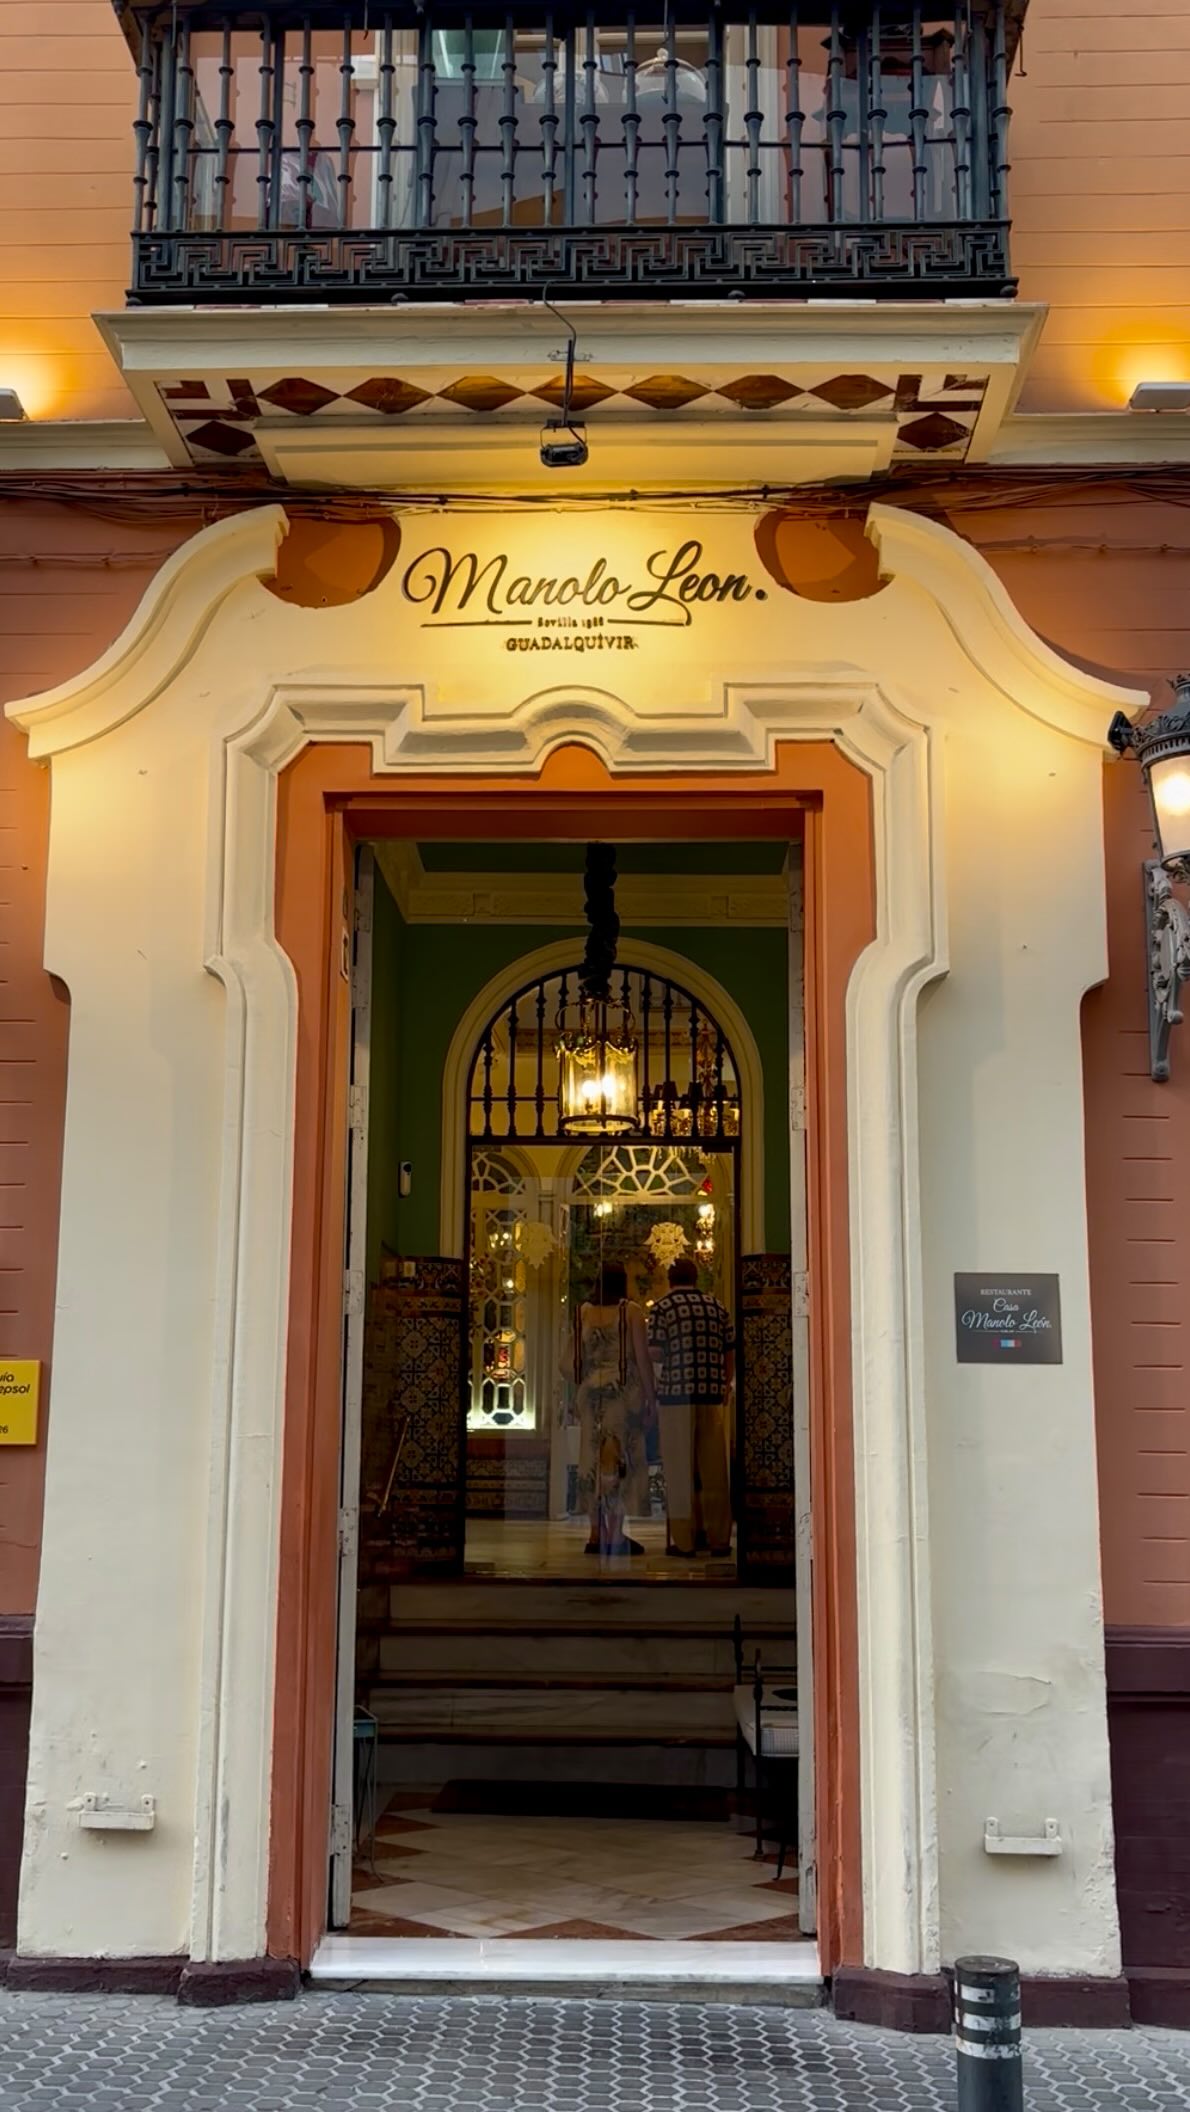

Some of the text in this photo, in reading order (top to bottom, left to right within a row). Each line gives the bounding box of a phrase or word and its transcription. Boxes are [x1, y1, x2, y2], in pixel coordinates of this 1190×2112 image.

[402, 547, 632, 615] Manolo
[980, 1288, 1032, 1296] RESTAURANTE
[993, 1297, 1019, 1312] Casa
[961, 1310, 1016, 1329] Manolo
